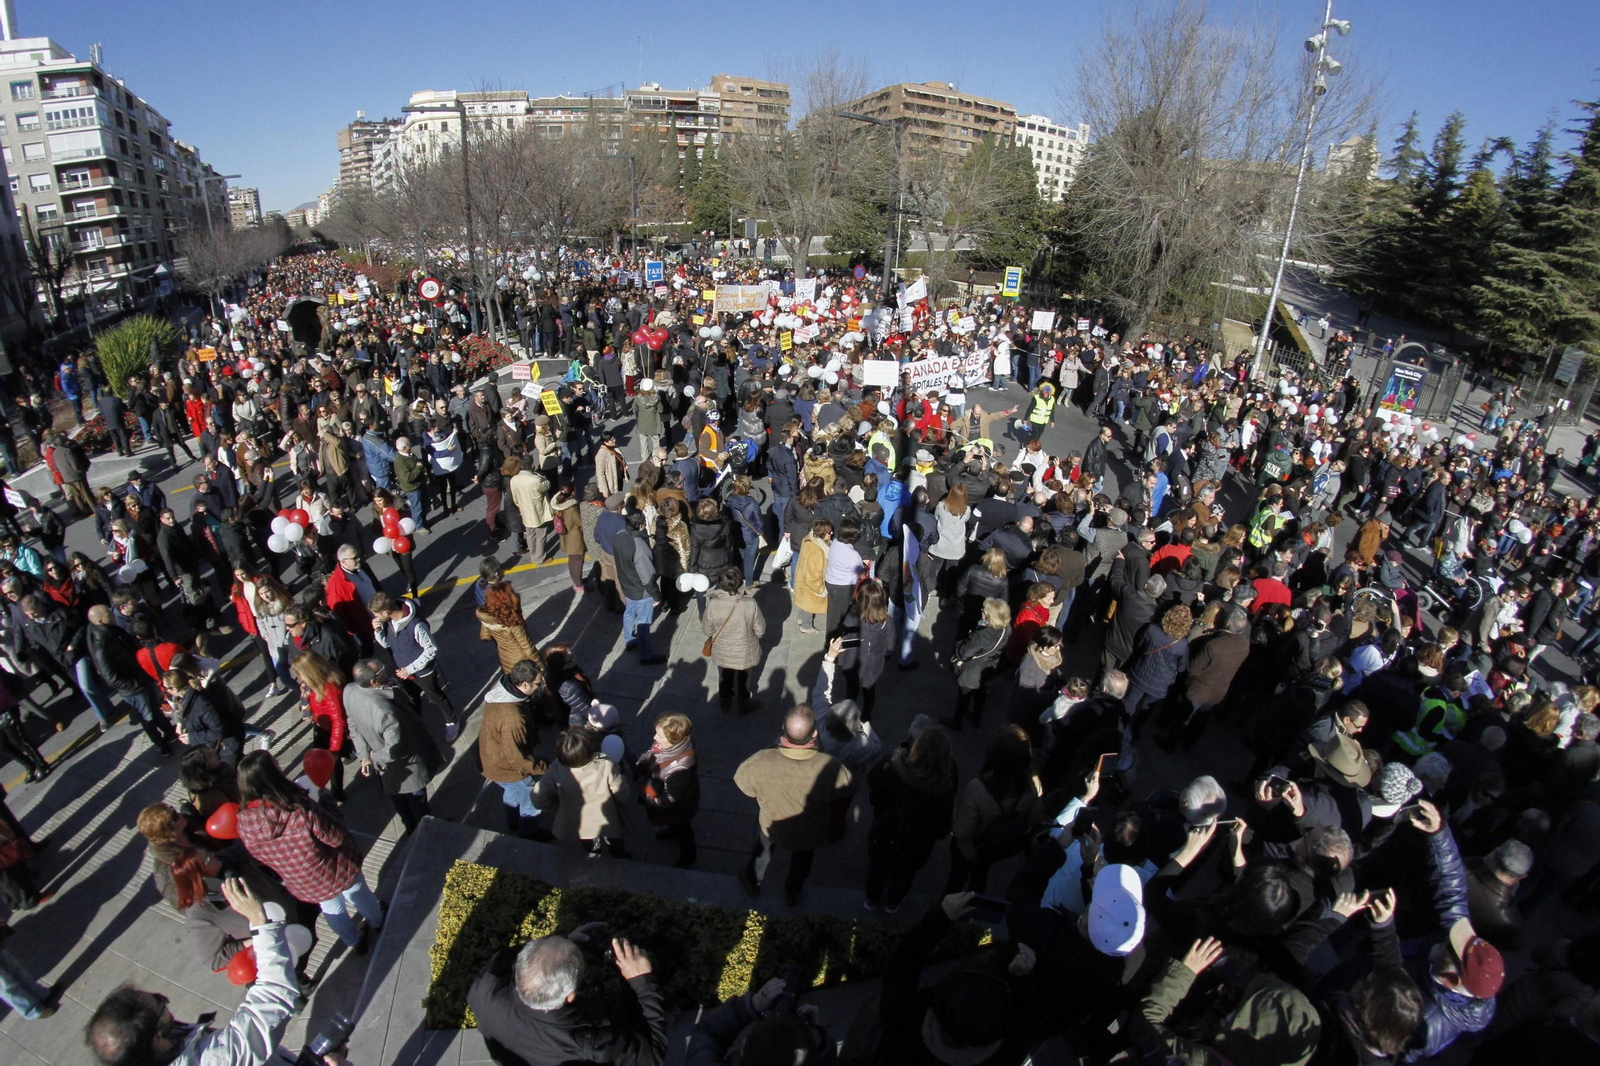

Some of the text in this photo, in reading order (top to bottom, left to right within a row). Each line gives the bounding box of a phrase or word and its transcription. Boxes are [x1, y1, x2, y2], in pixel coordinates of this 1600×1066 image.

[717, 299, 732, 310] DOS
[903, 360, 949, 378] RANADA
[951, 353, 981, 370] EXIGE
